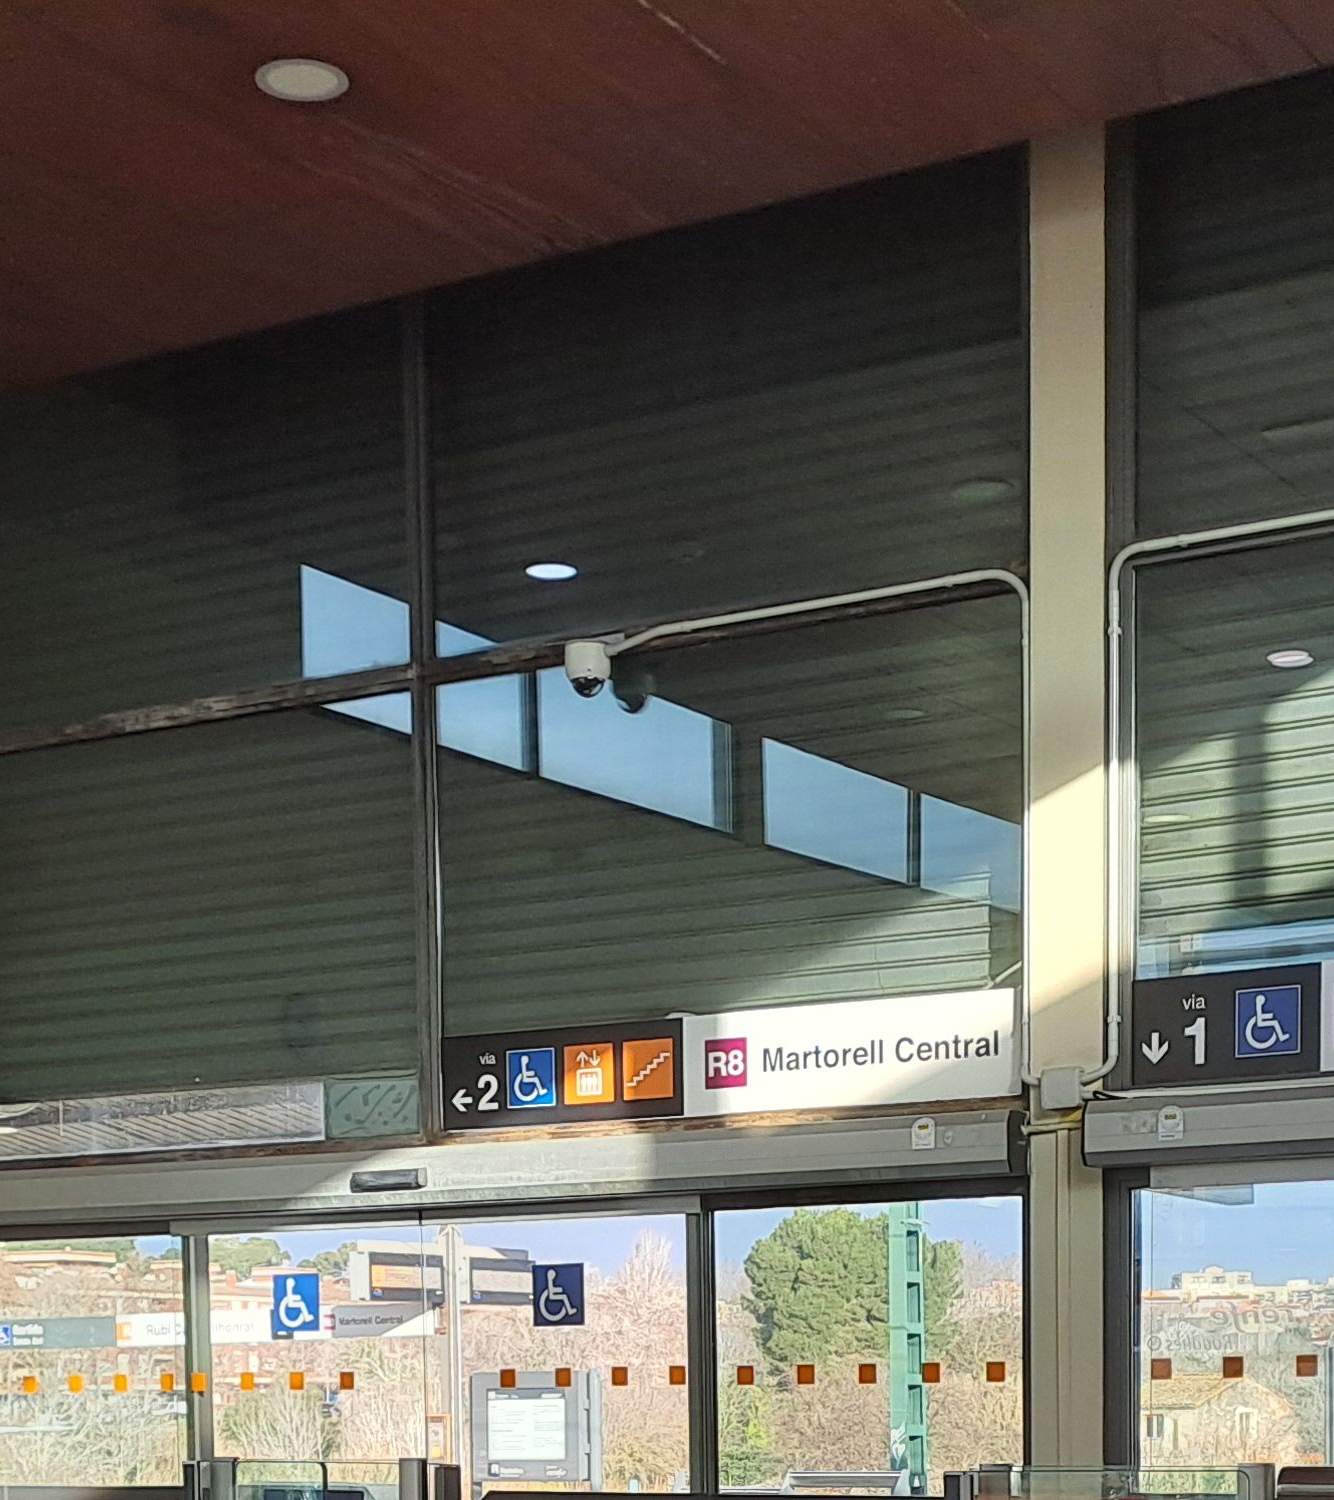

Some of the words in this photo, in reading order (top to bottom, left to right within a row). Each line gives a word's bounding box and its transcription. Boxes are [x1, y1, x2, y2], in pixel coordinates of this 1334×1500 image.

[762, 1039, 884, 1073] Martorell
[895, 1030, 999, 1063] Central
[1184, 1017, 1206, 1065] 1
[708, 1049, 745, 1078] R8
[477, 1074, 499, 1111] 2
[374, 1315, 404, 1325] Central
